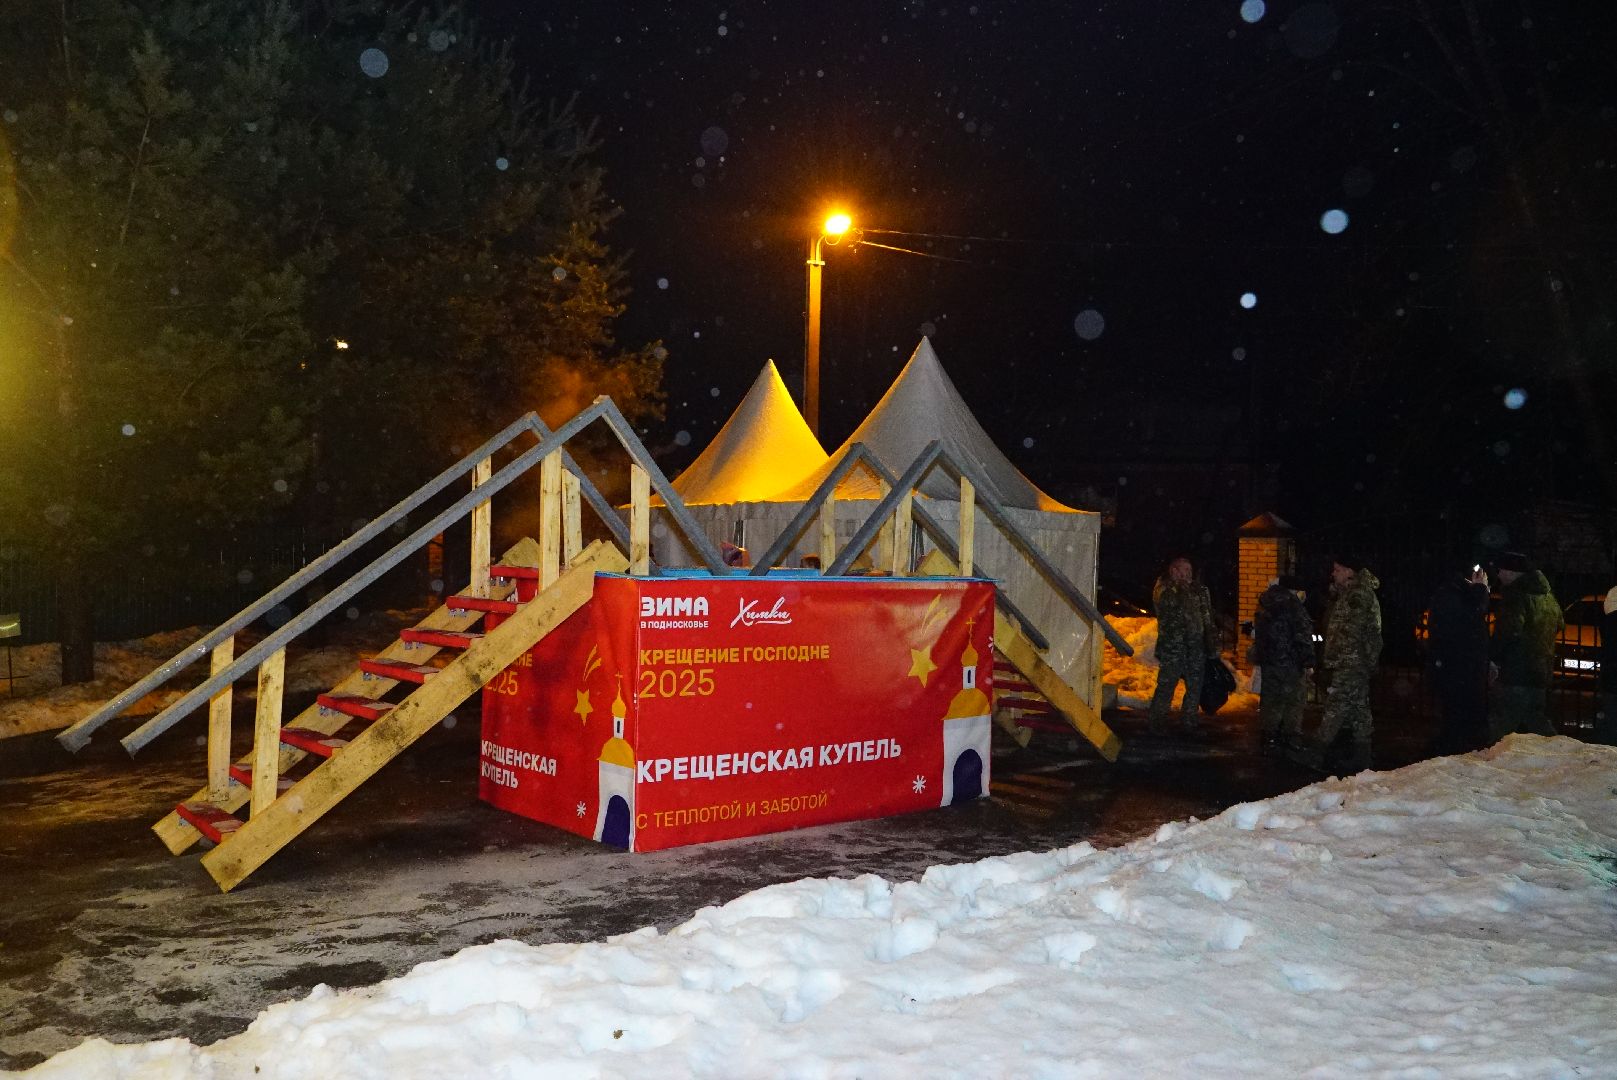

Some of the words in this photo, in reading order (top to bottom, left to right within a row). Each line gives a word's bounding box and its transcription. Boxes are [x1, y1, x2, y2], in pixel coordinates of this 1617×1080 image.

[640, 596, 709, 617] ЗИМА
[730, 596, 793, 629] Химки
[648, 620, 709, 630] ПОДМОСКОВЬЕ
[639, 647, 740, 666] КРЕЩЕНИЕ
[743, 645, 830, 663] ГОСПОДНЕ
[638, 668, 715, 699] 2025
[481, 739, 557, 777] КРЕЩЕНСКАЯ
[637, 746, 815, 784] КРЕЩЕНСКАЯ
[819, 738, 901, 767] КУПЕЛЬ
[481, 760, 519, 789] КУПЕЛЬ
[636, 813, 649, 830] С
[653, 800, 742, 828] ТЕПЛОТОЙ
[745, 802, 757, 817] И
[760, 789, 829, 816] ЗАБОТОЙ
